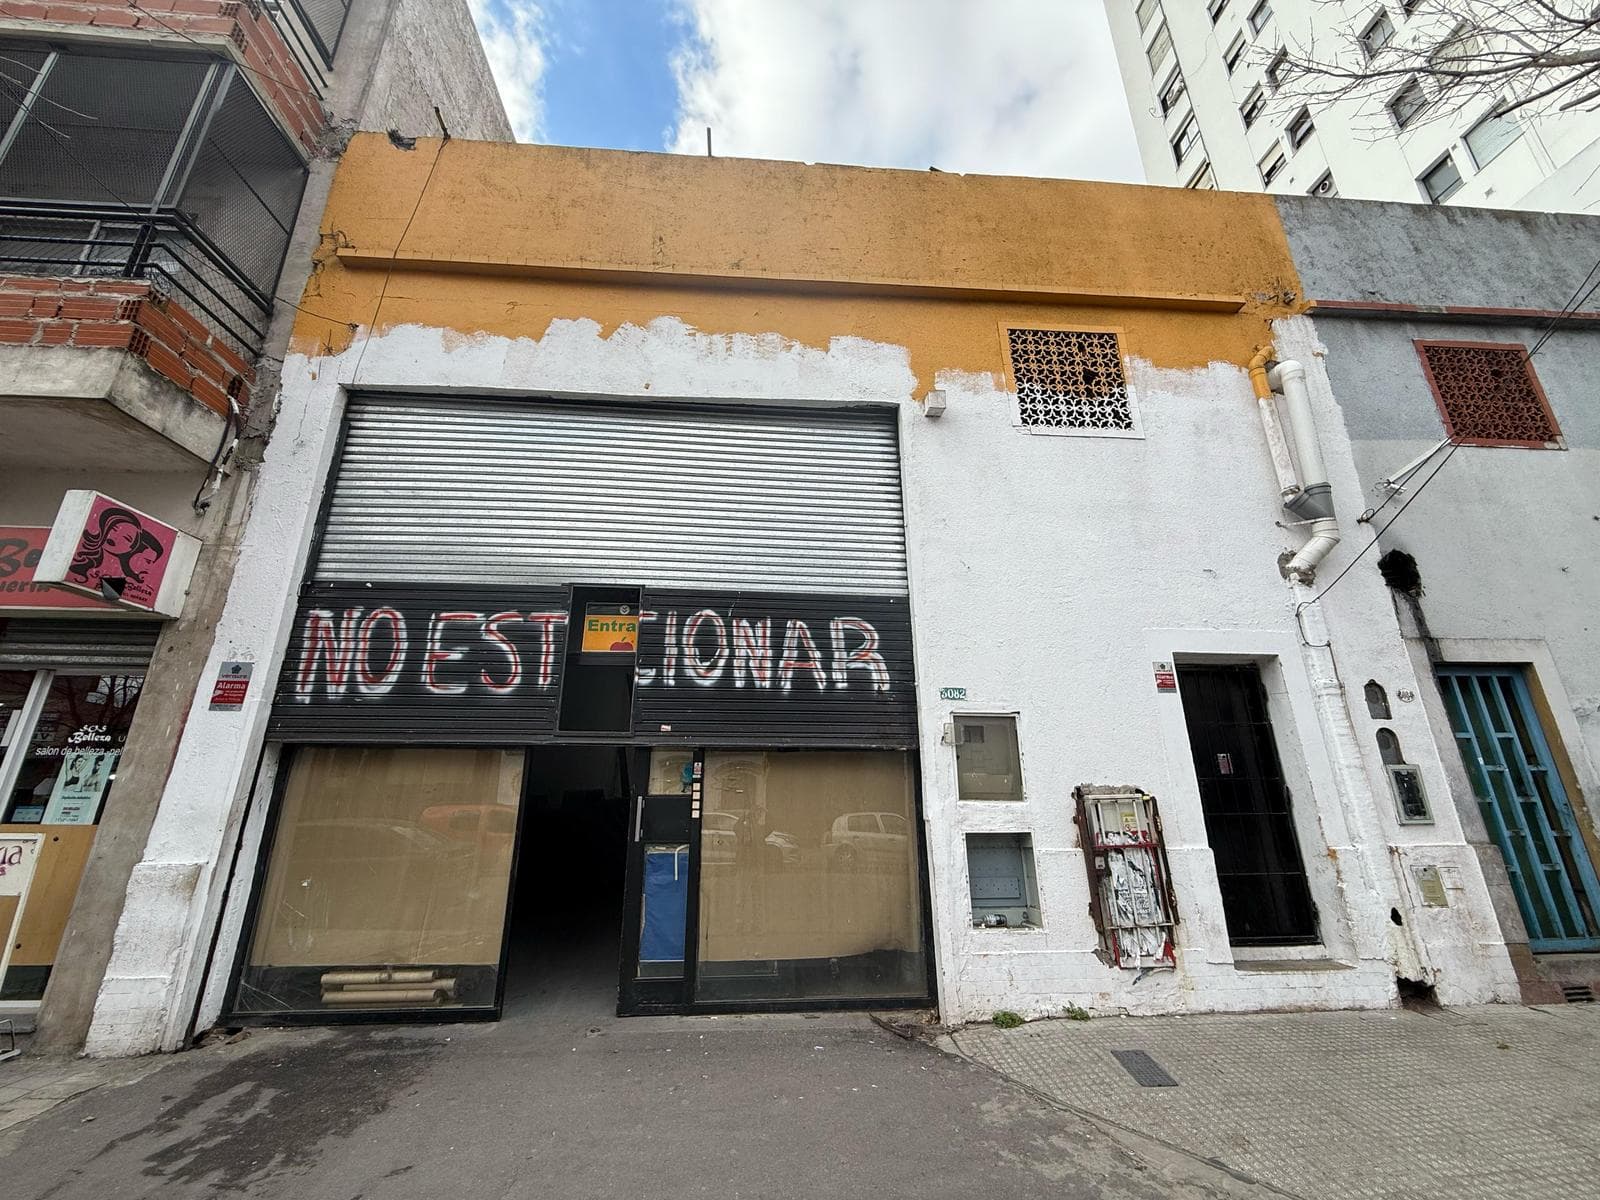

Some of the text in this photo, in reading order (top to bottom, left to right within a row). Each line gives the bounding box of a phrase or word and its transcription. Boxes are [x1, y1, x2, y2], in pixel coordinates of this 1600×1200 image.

[587, 619, 637, 632] Entra
[296, 606, 408, 704] NO
[216, 682, 246, 690] Alarma
[35, 744, 60, 756] salon
